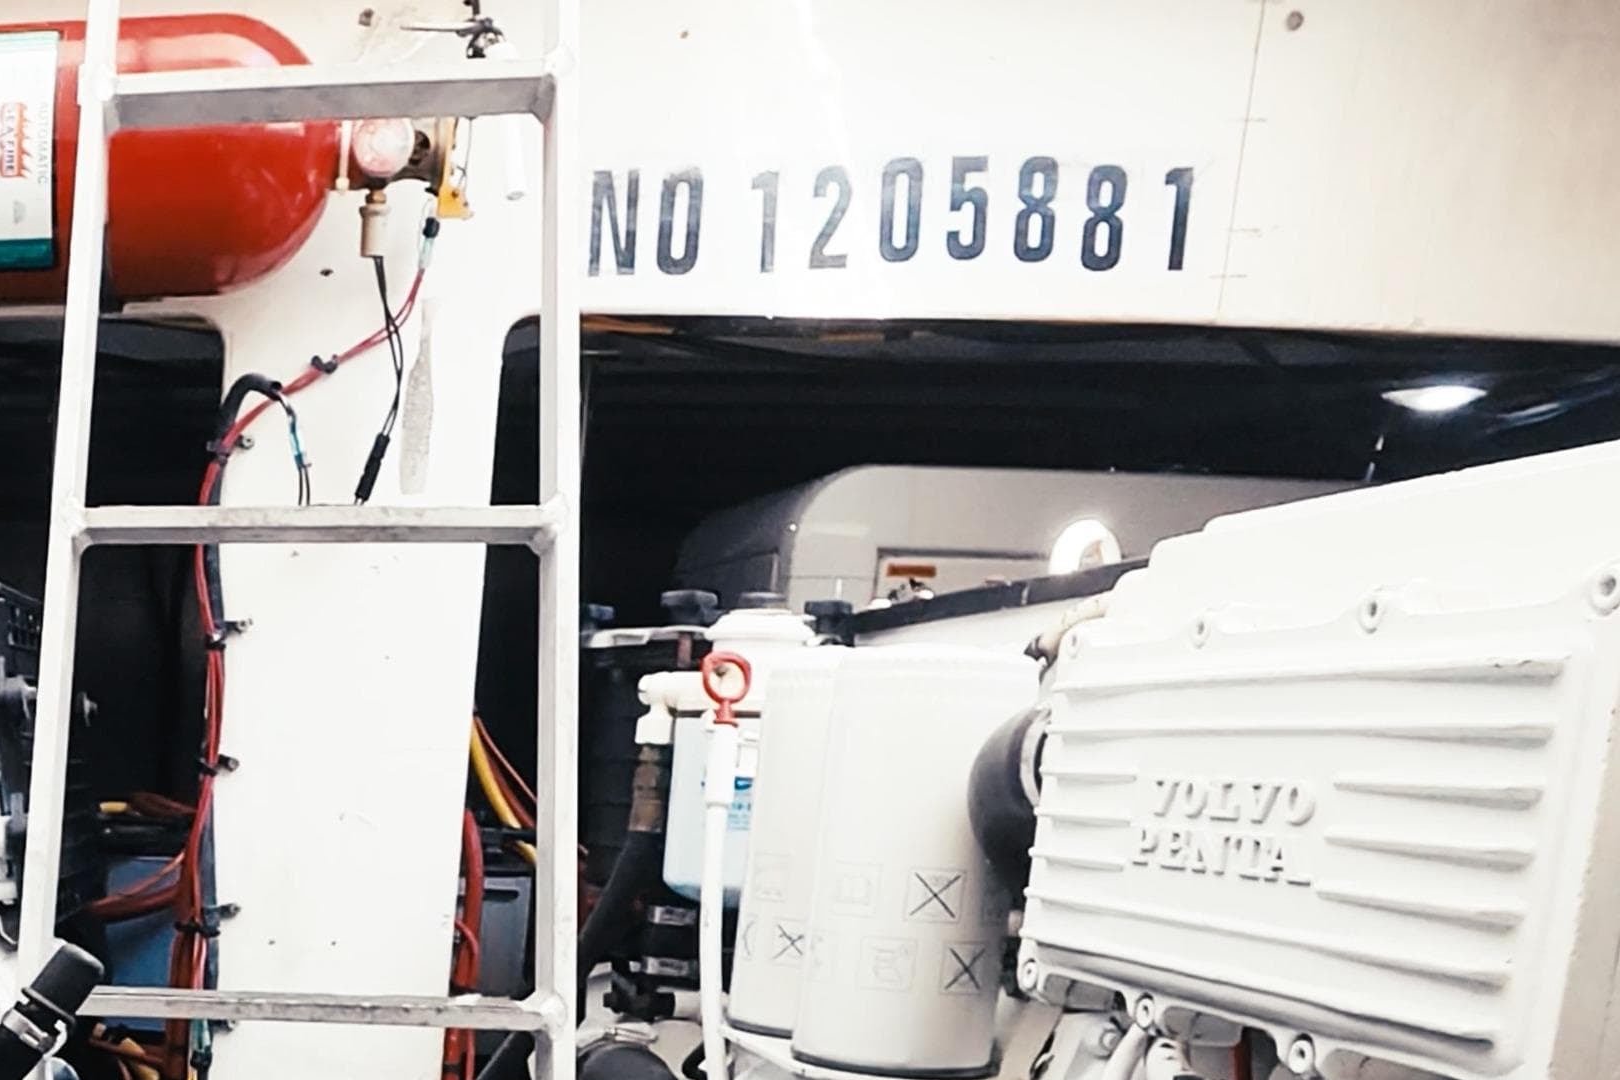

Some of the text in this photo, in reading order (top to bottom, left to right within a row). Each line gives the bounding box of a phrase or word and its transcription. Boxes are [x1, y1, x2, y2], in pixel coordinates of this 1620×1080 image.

[36, 101, 49, 186] AUTOMATIC
[587, 155, 1195, 276] NO 1205881
[1148, 777, 1316, 827] VOLVO
[1131, 825, 1312, 887] PENTA
